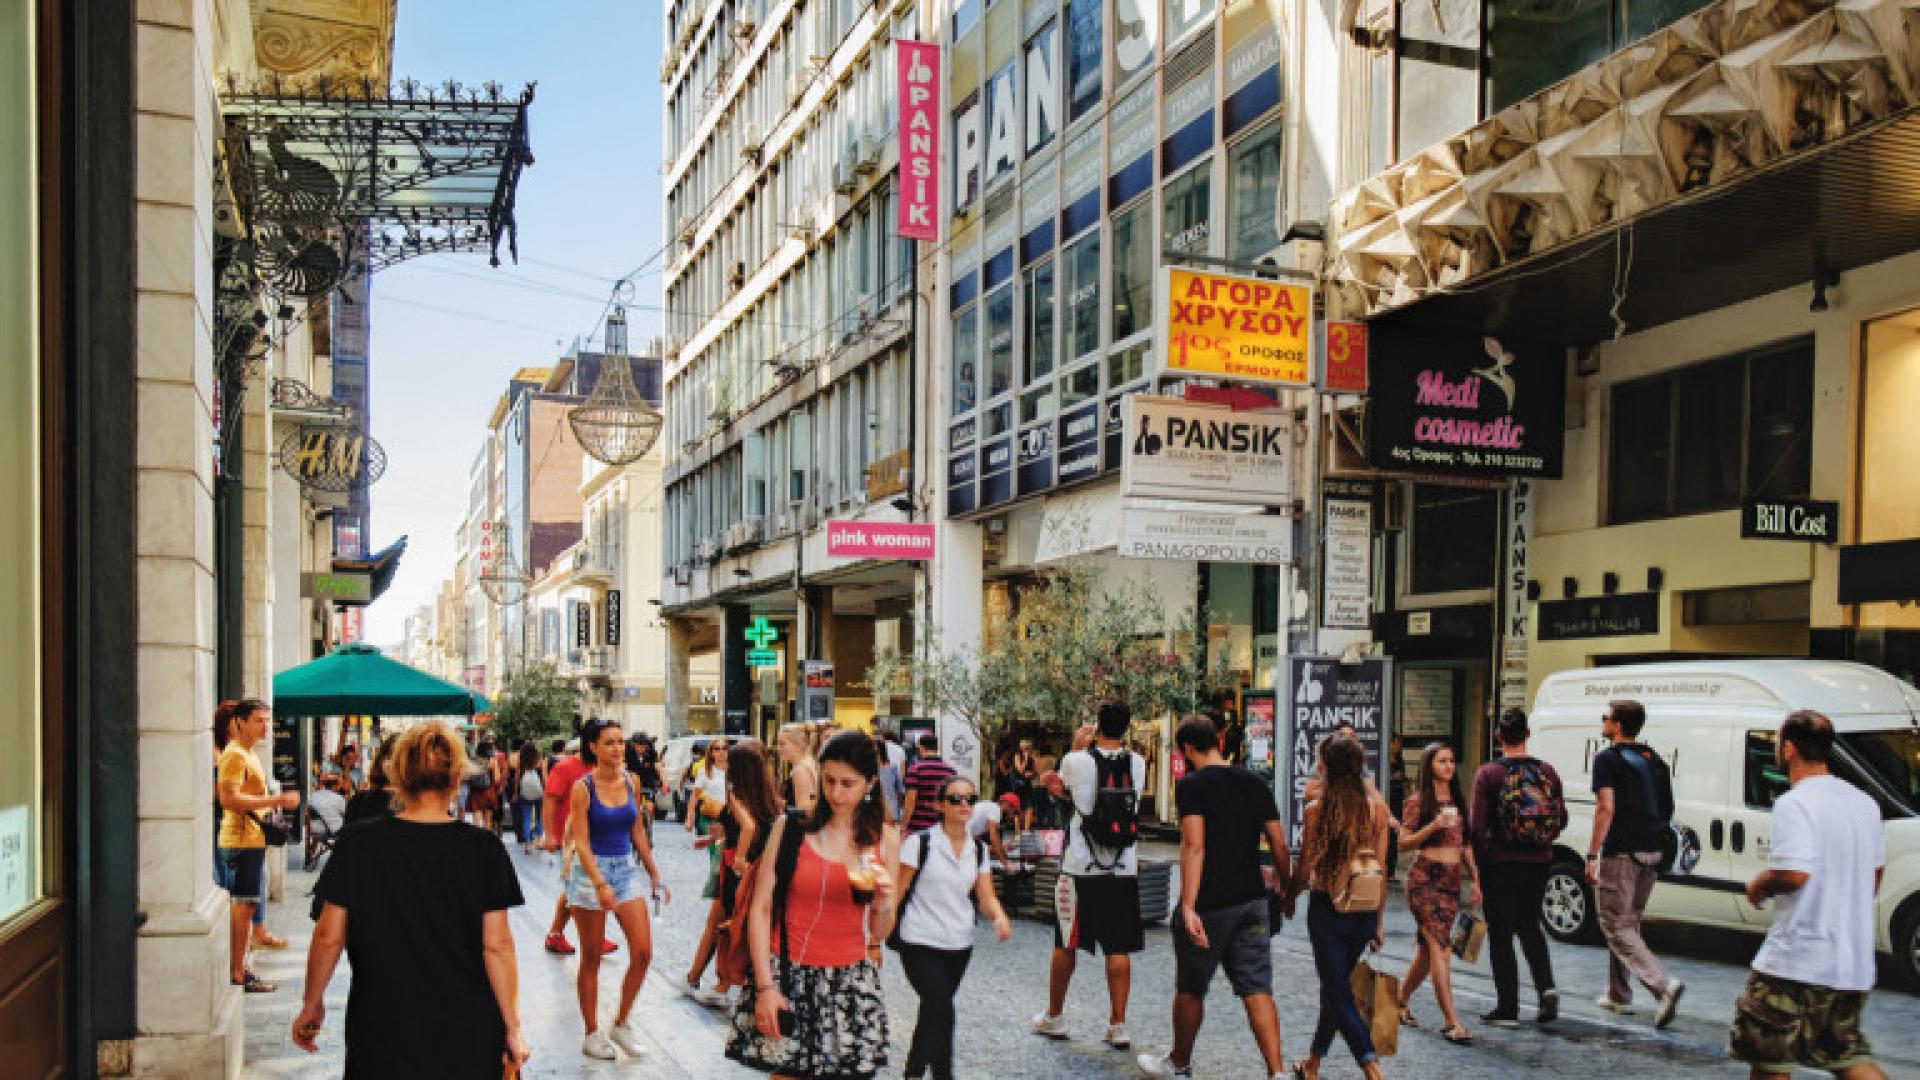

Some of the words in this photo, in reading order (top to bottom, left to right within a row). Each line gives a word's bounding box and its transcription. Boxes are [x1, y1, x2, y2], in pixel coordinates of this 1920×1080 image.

[1187, 276, 1294, 312] ΑΓΟΡΑ
[1173, 299, 1305, 337] ΧΡΥΣΟΥ
[1239, 344, 1305, 362] ΟΡΟΦΟΣ
[1415, 370, 1480, 409] Medi
[1414, 416, 1525, 449] cosmetic
[1756, 504, 1786, 533] Bill
[1789, 506, 1827, 536] Cost
[831, 528, 867, 547] pink
[871, 534, 931, 548] woman
[1134, 542, 1281, 561] PANAGOPOULOS
